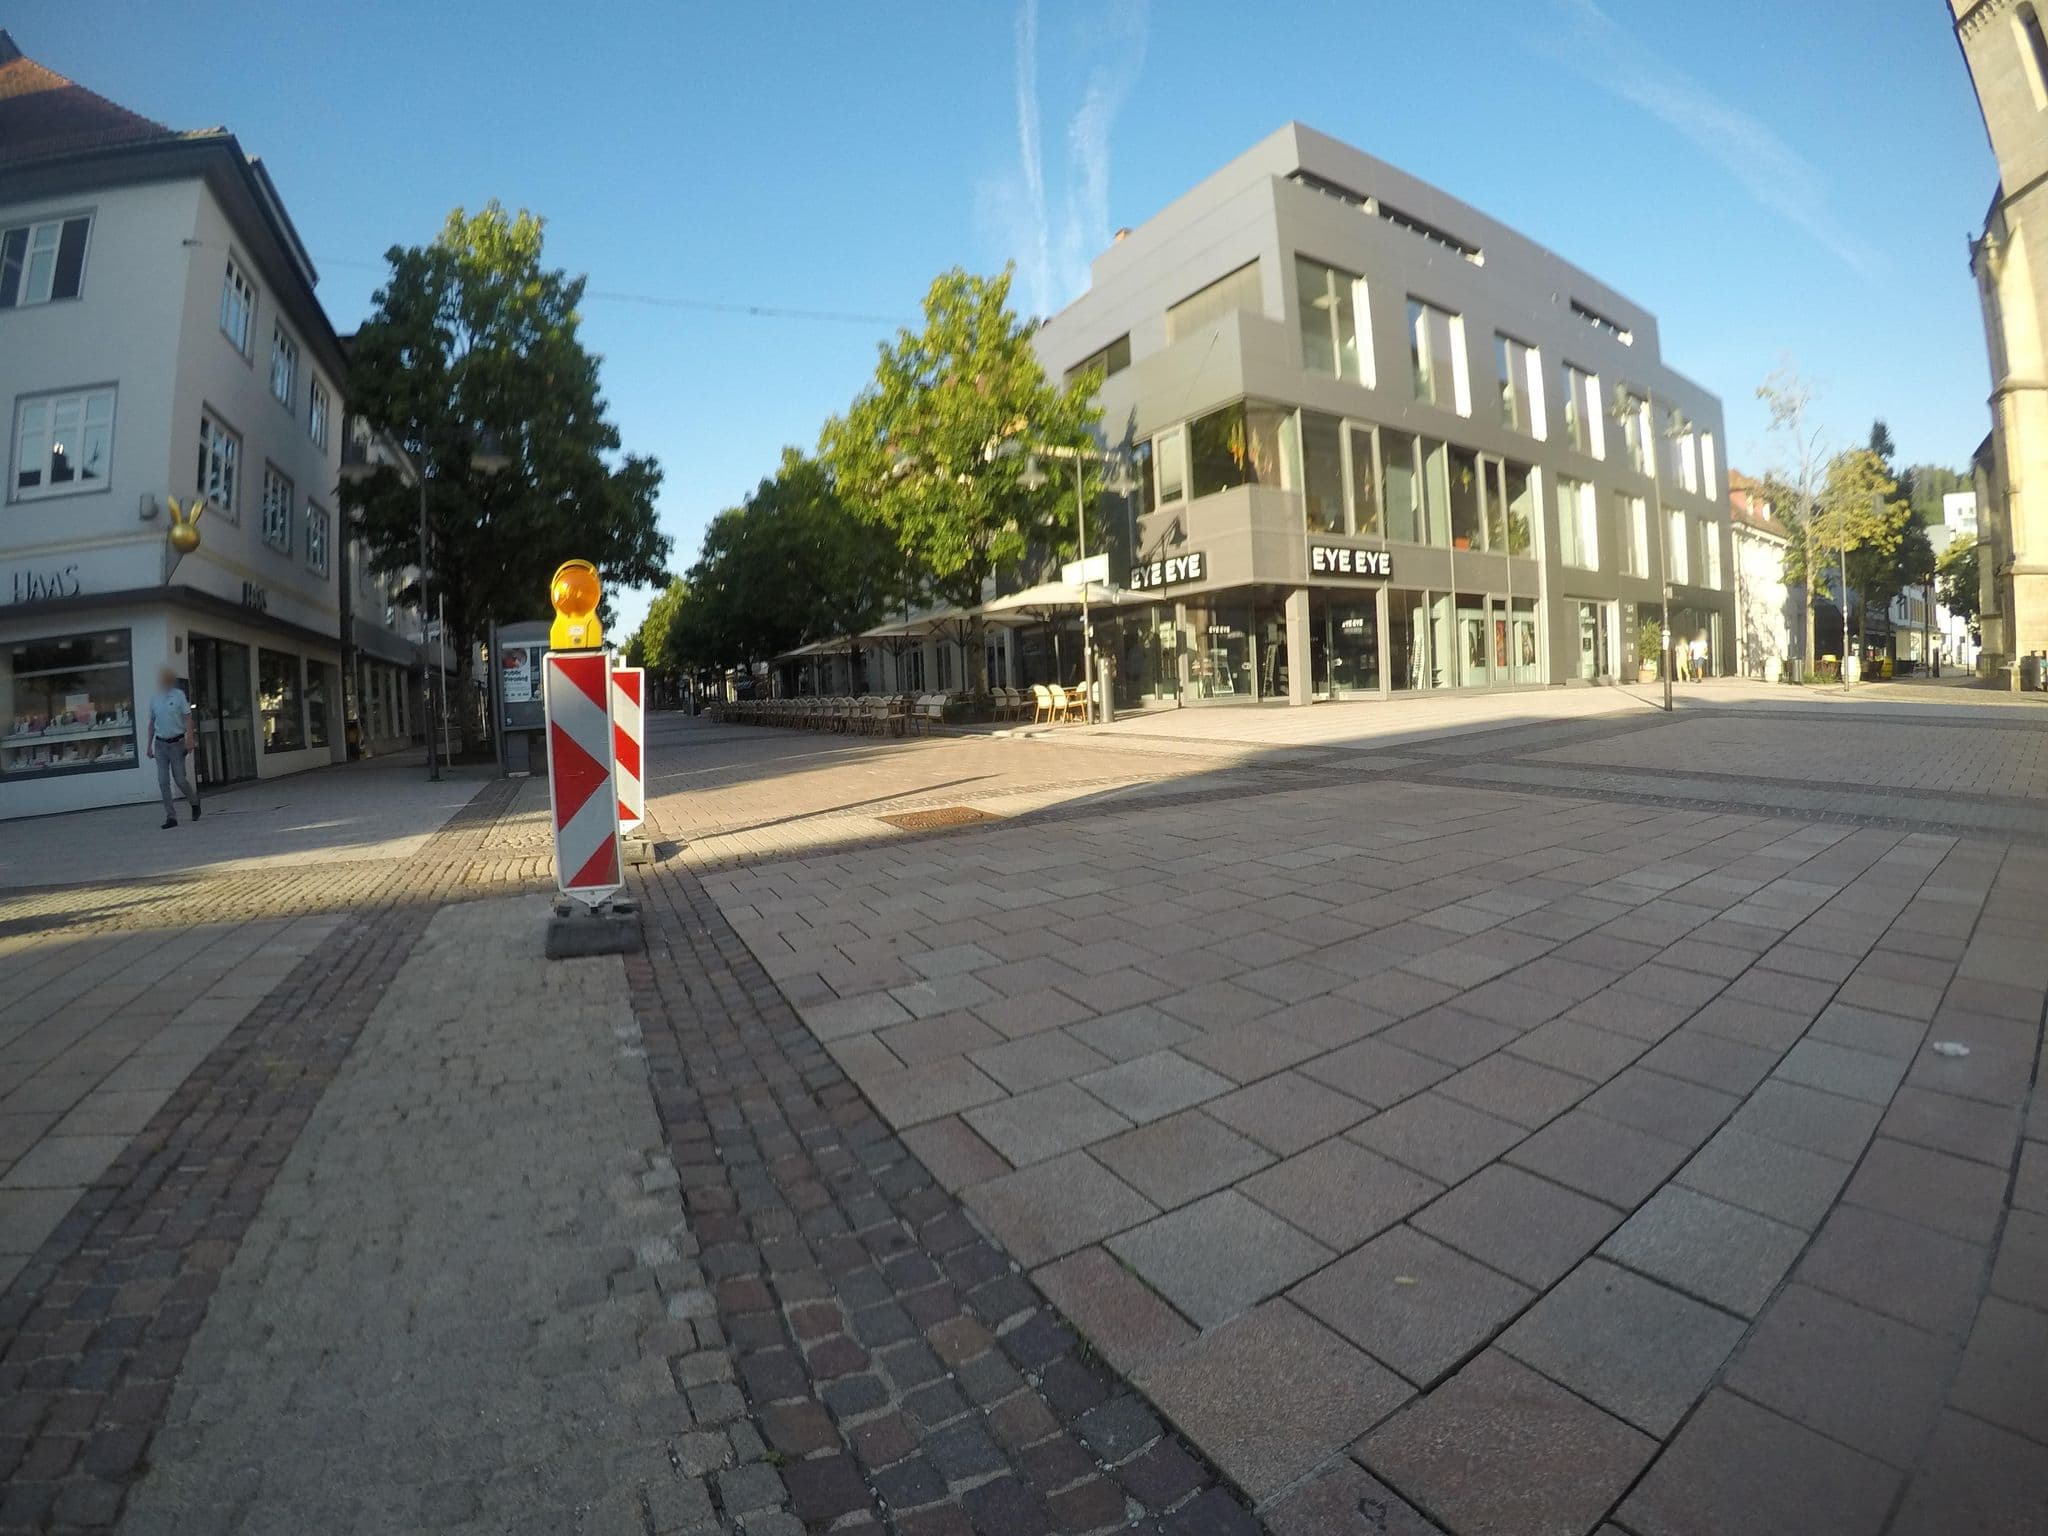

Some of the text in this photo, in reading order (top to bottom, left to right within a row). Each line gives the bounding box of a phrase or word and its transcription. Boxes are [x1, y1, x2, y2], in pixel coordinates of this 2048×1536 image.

[1130, 553, 1200, 590] EYE EYE
[1312, 546, 1390, 575] EYE EYE
[14, 564, 79, 602] HAAS
